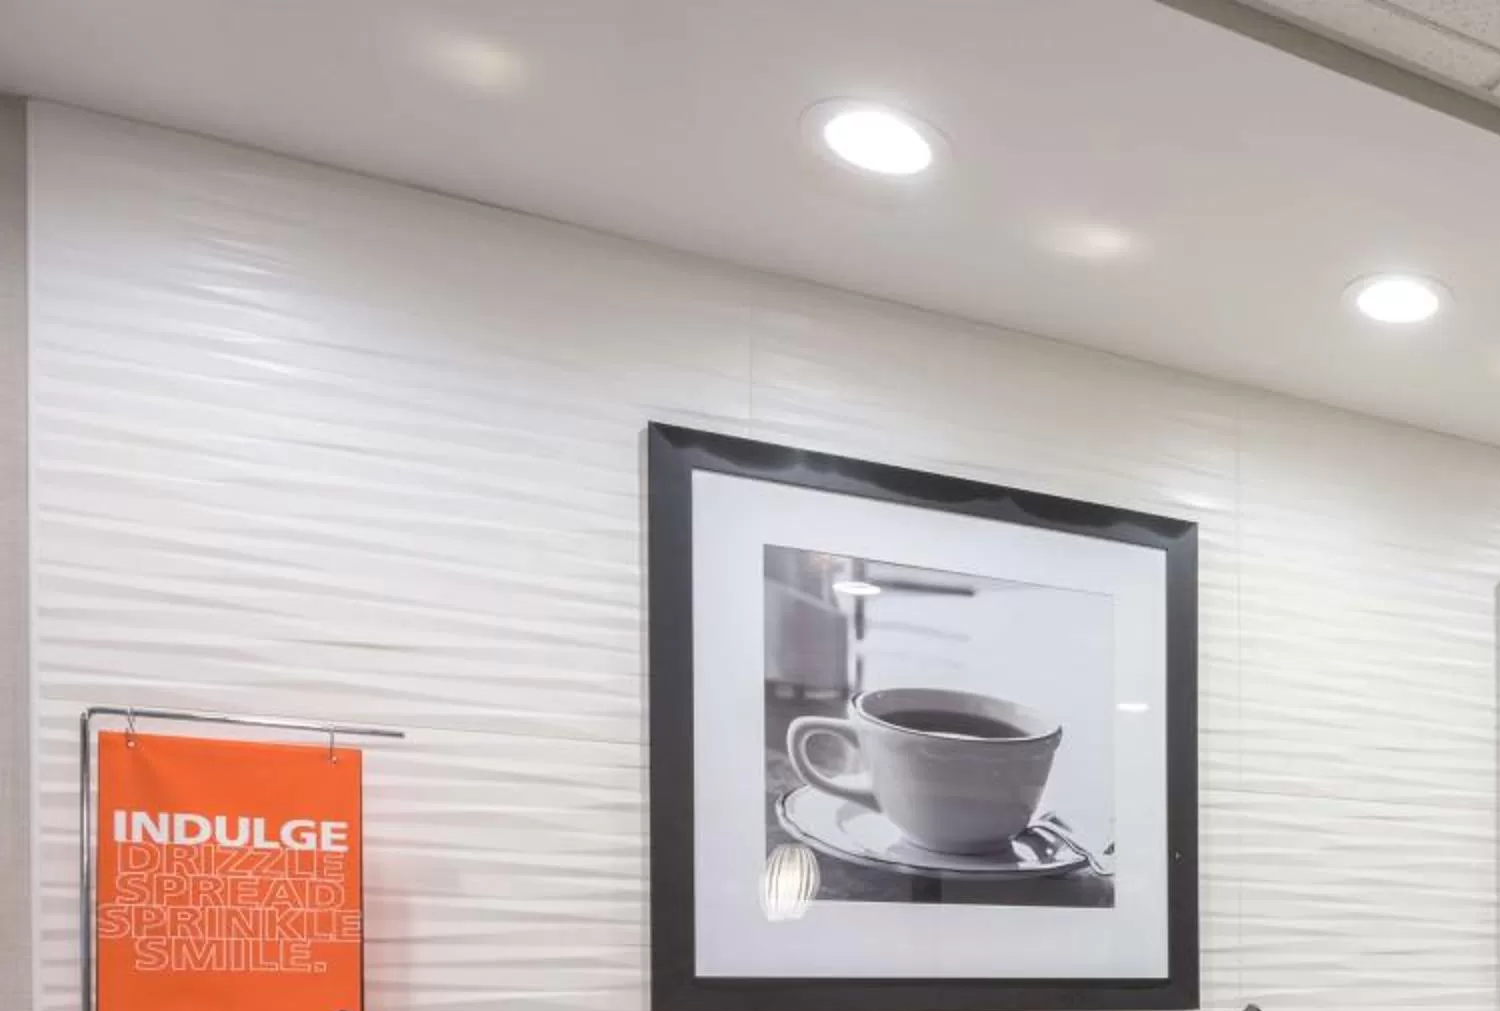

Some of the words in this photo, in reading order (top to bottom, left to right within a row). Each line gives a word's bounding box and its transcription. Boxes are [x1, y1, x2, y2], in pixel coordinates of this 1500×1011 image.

[113, 809, 349, 853] INDULGE
[117, 841, 345, 882] DRIZZLE
[115, 872, 345, 911] SPREAD
[97, 903, 362, 942] SPRINKLE
[135, 936, 328, 973] SMILE.
